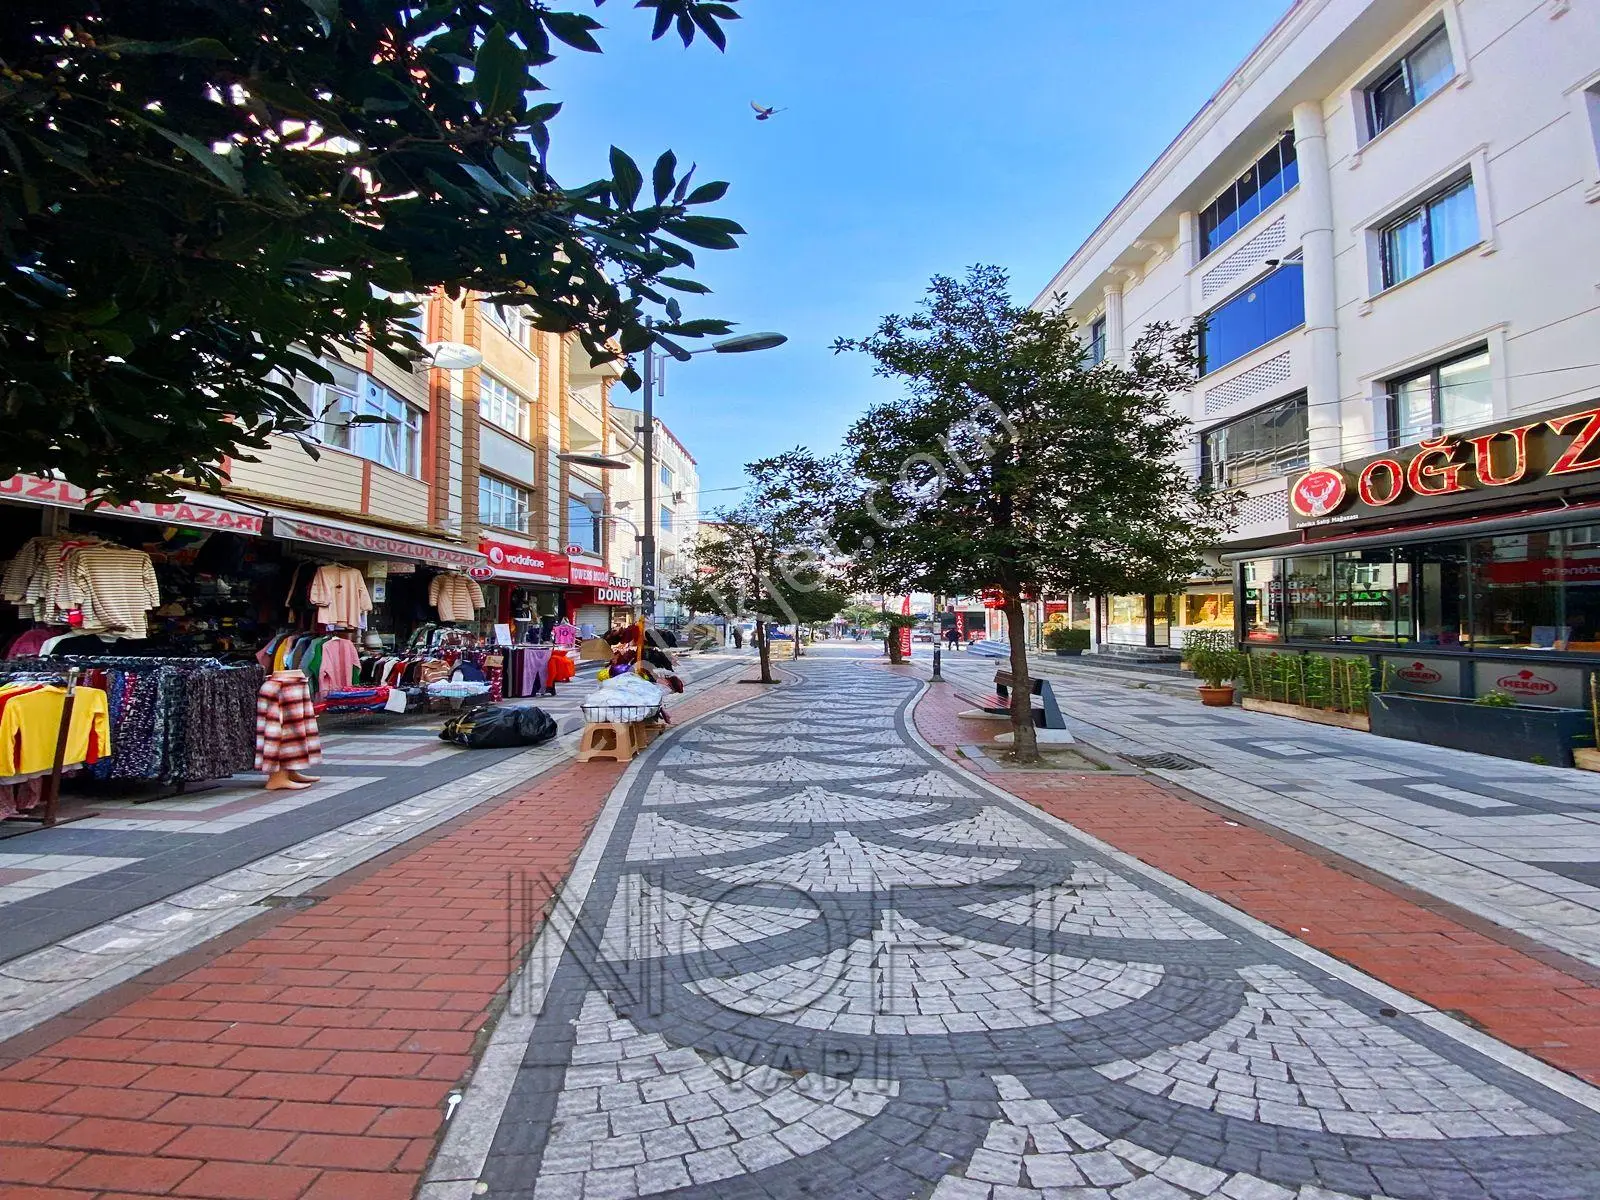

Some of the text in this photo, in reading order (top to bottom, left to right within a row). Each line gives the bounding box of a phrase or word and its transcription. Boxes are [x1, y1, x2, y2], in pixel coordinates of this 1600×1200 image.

[1357, 406, 1600, 507] OĞUZ
[154, 503, 262, 532] PAZARI
[362, 535, 434, 560] UCUZLUK
[505, 554, 544, 569] vodafone
